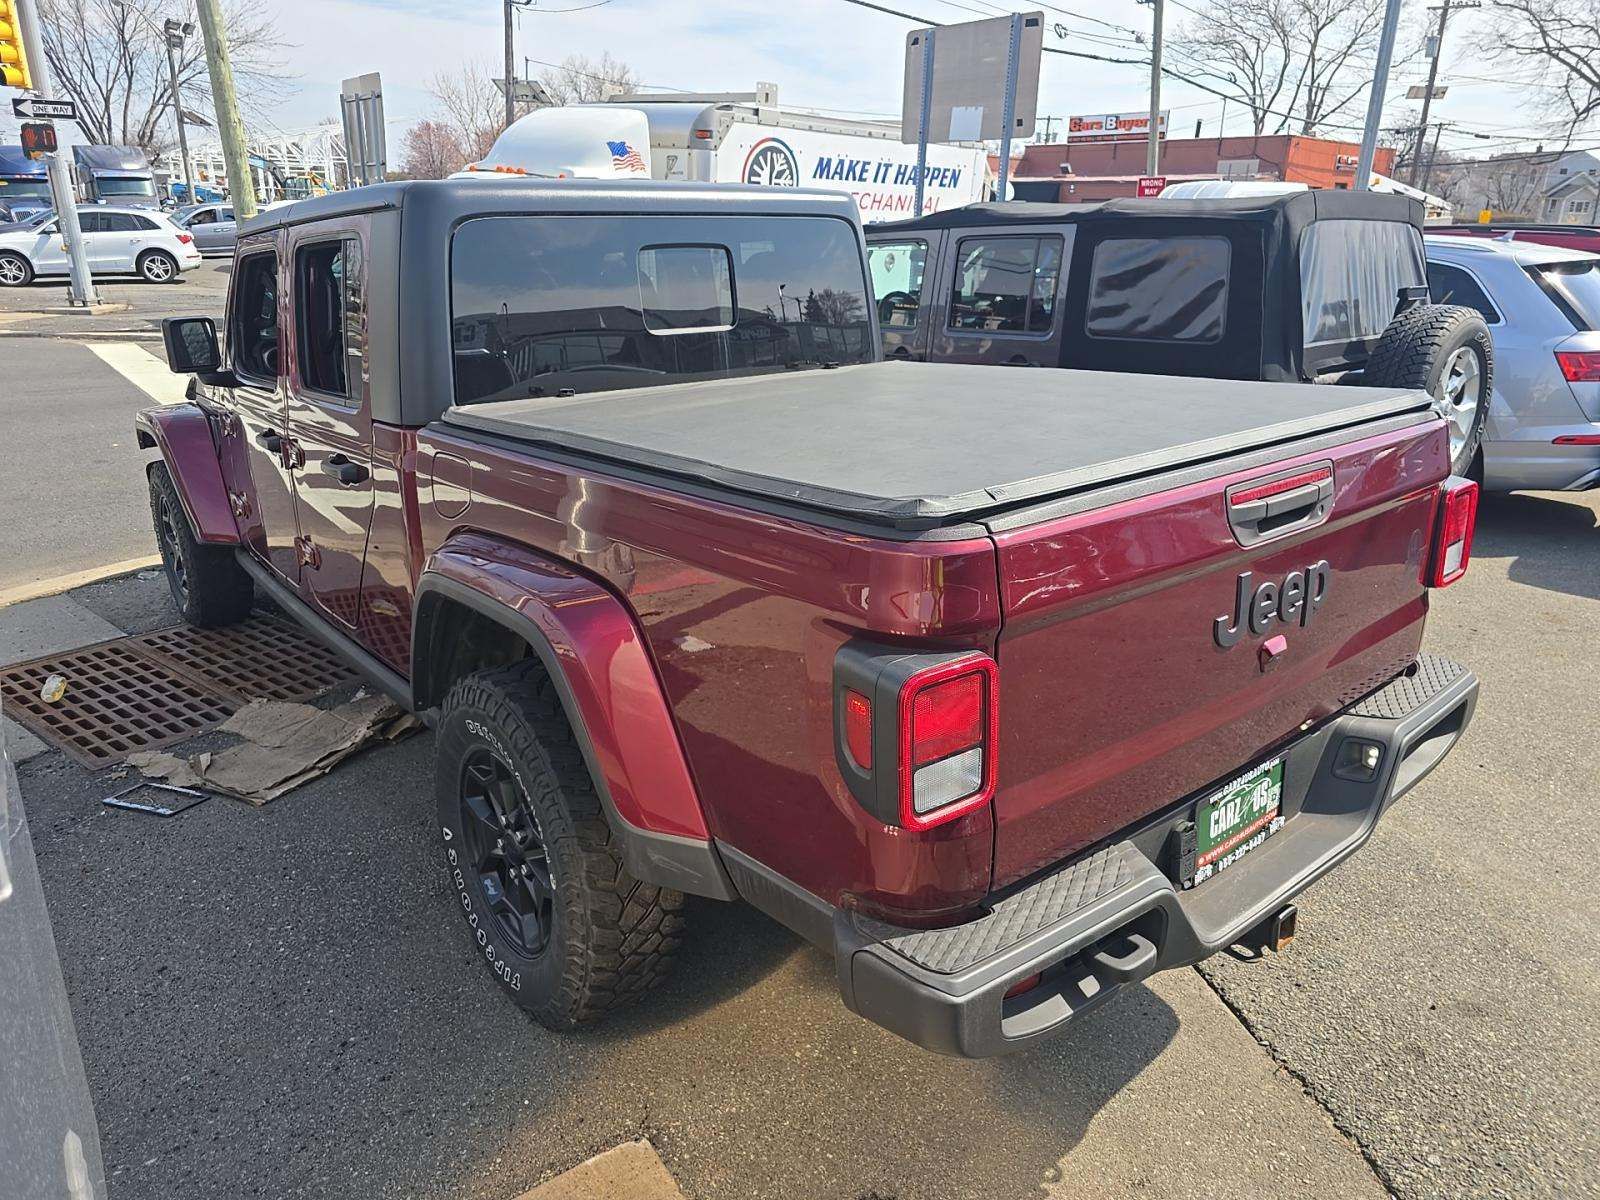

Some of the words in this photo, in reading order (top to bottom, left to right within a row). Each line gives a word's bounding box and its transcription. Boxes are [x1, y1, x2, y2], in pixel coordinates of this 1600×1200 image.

[32, 104, 48, 113] ONE
[51, 106, 69, 114] WAY
[1069, 117, 1103, 132] Cars
[812, 156, 872, 183] MAKE
[872, 161, 893, 184] IT
[1141, 179, 1163, 187] WRONG
[1144, 188, 1158, 196] WAY
[851, 191, 940, 213] CHANIAL
[1213, 559, 1331, 648] Jeep
